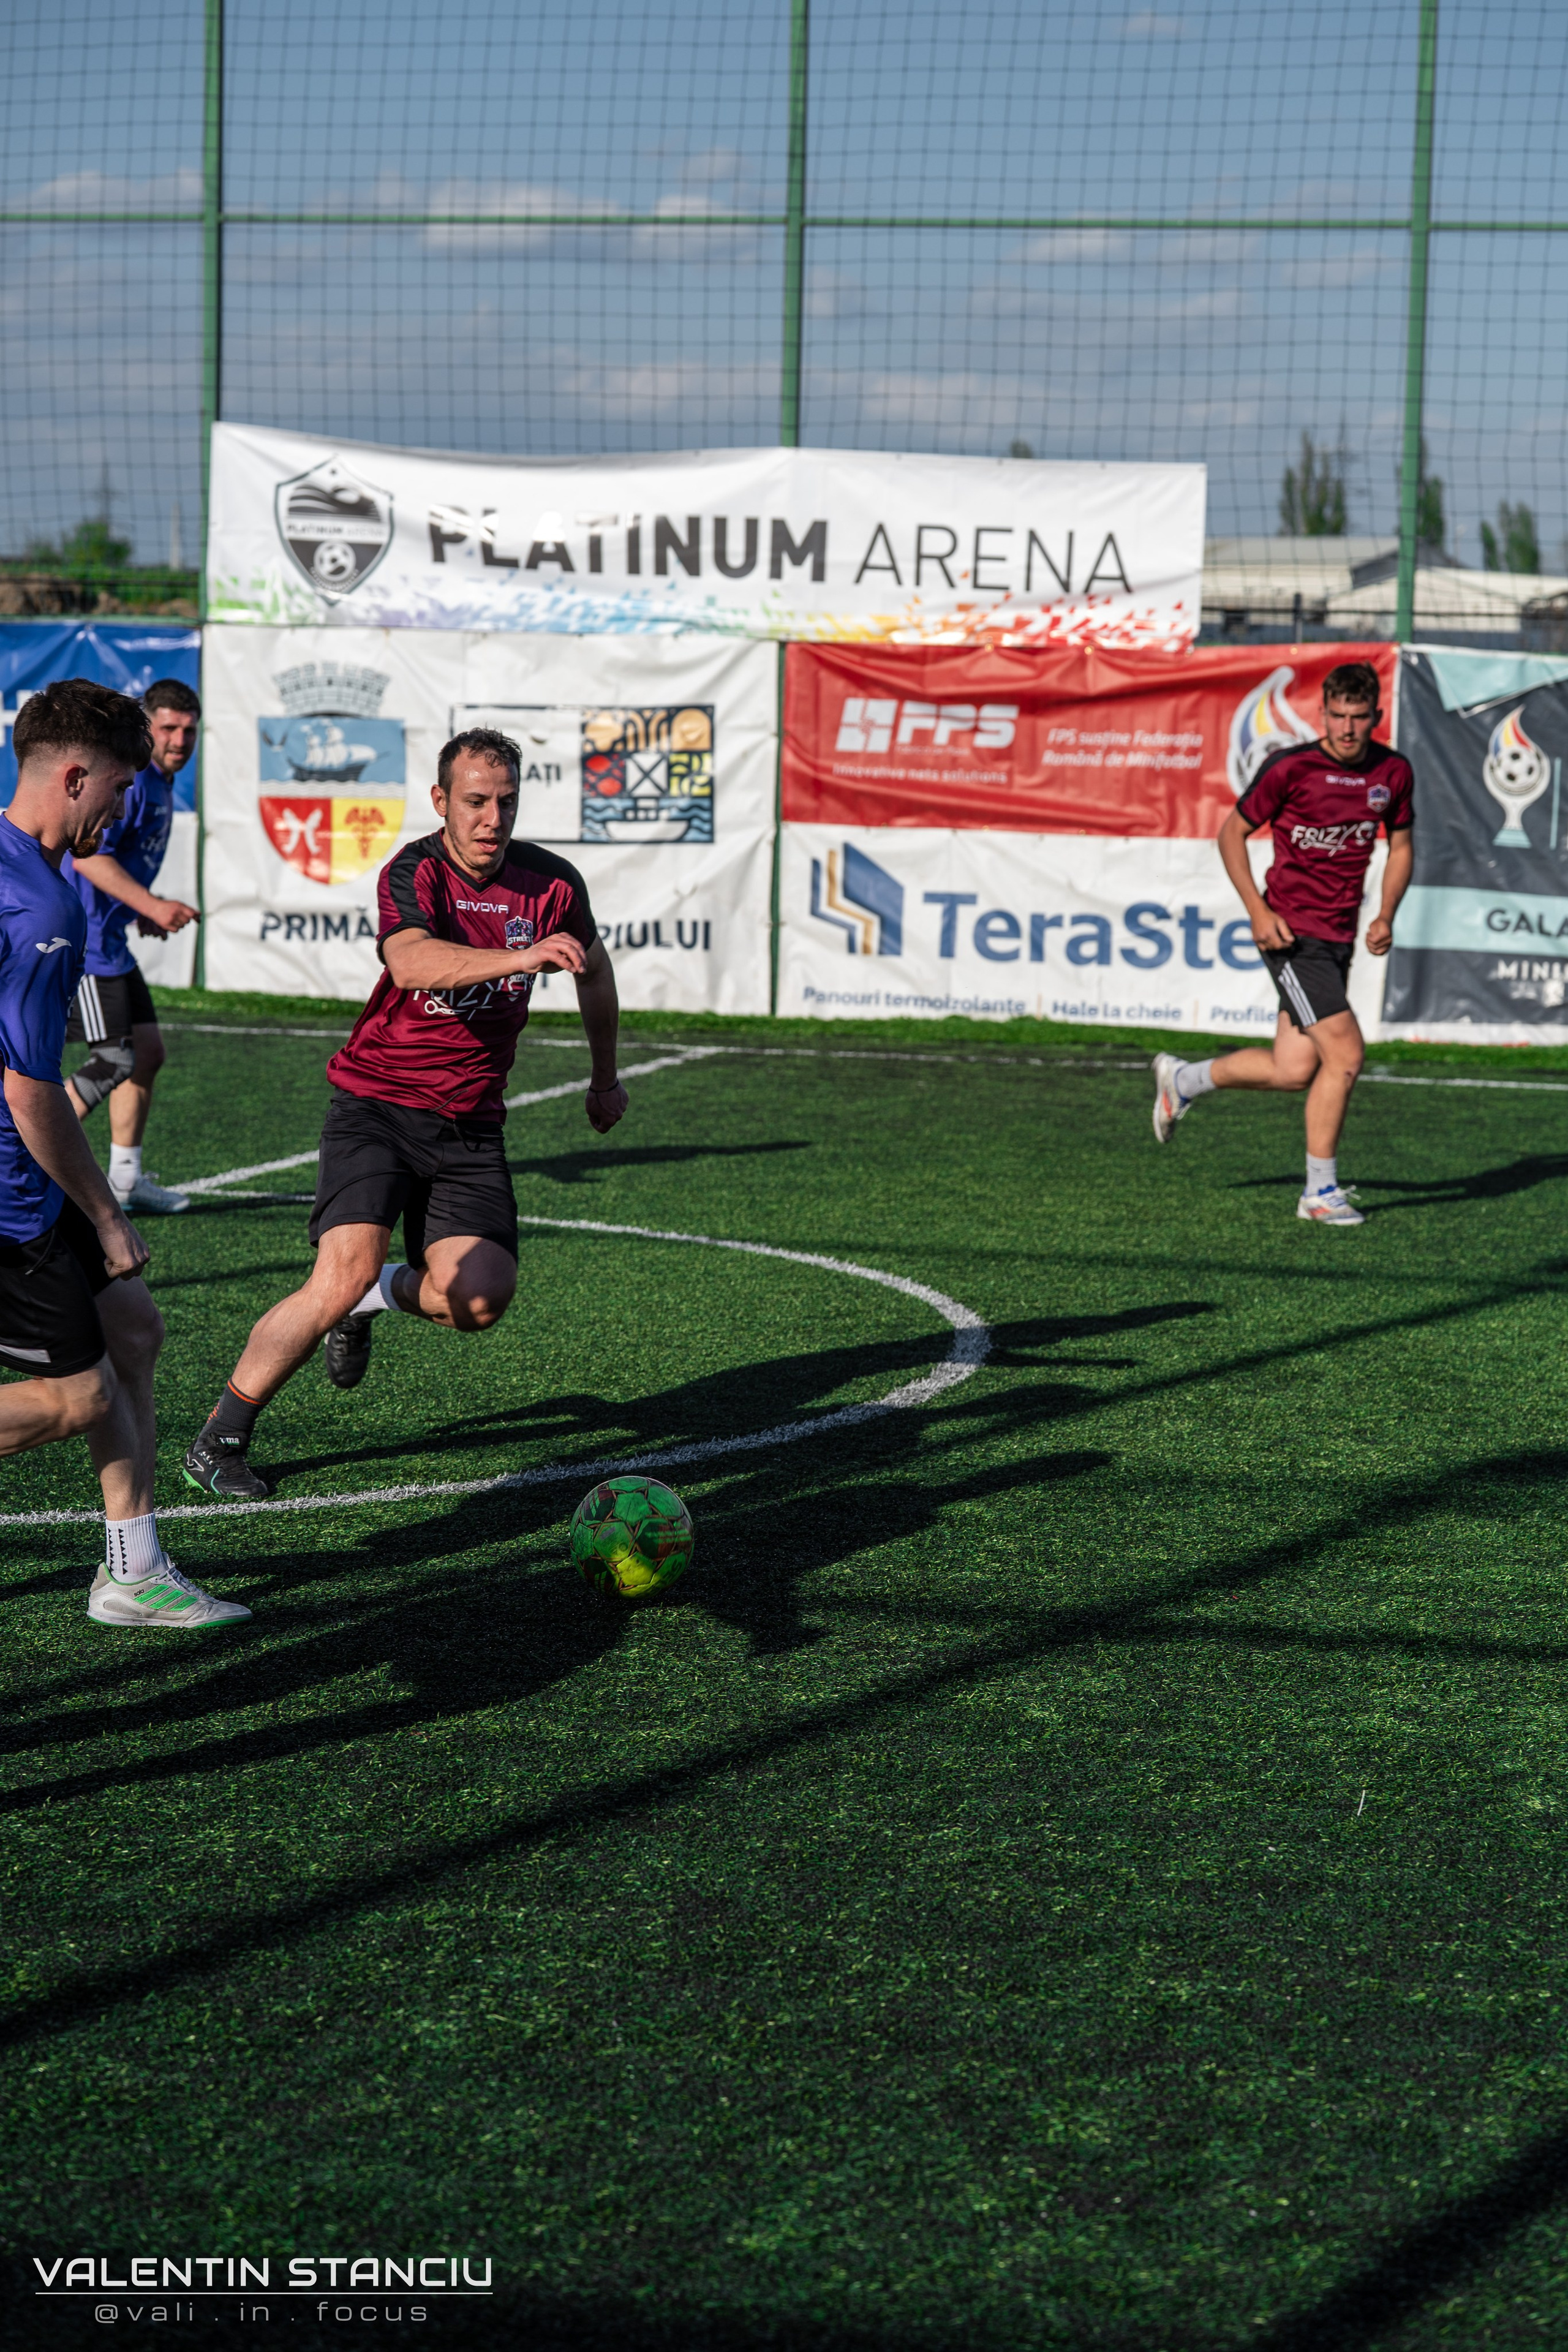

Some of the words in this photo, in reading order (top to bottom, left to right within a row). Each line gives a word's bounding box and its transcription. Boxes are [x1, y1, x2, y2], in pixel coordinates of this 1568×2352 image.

[429, 504, 828, 582] PLATINUM
[854, 522, 1133, 594] ARENA
[896, 700, 1020, 748] FPS
[522, 763, 562, 788] AȚI
[456, 899, 509, 914] GIVOVA
[260, 907, 375, 941] PRIMĂ
[597, 920, 711, 951] PIULUI
[508, 936, 530, 945] STREET
[922, 892, 1266, 971] TeraSte
[1497, 959, 1568, 982] MINI
[802, 986, 881, 1006] Panouri
[1052, 1000, 1099, 1018] Hale
[1102, 1001, 1121, 1019] la
[1126, 1003, 1182, 1021] cheie
